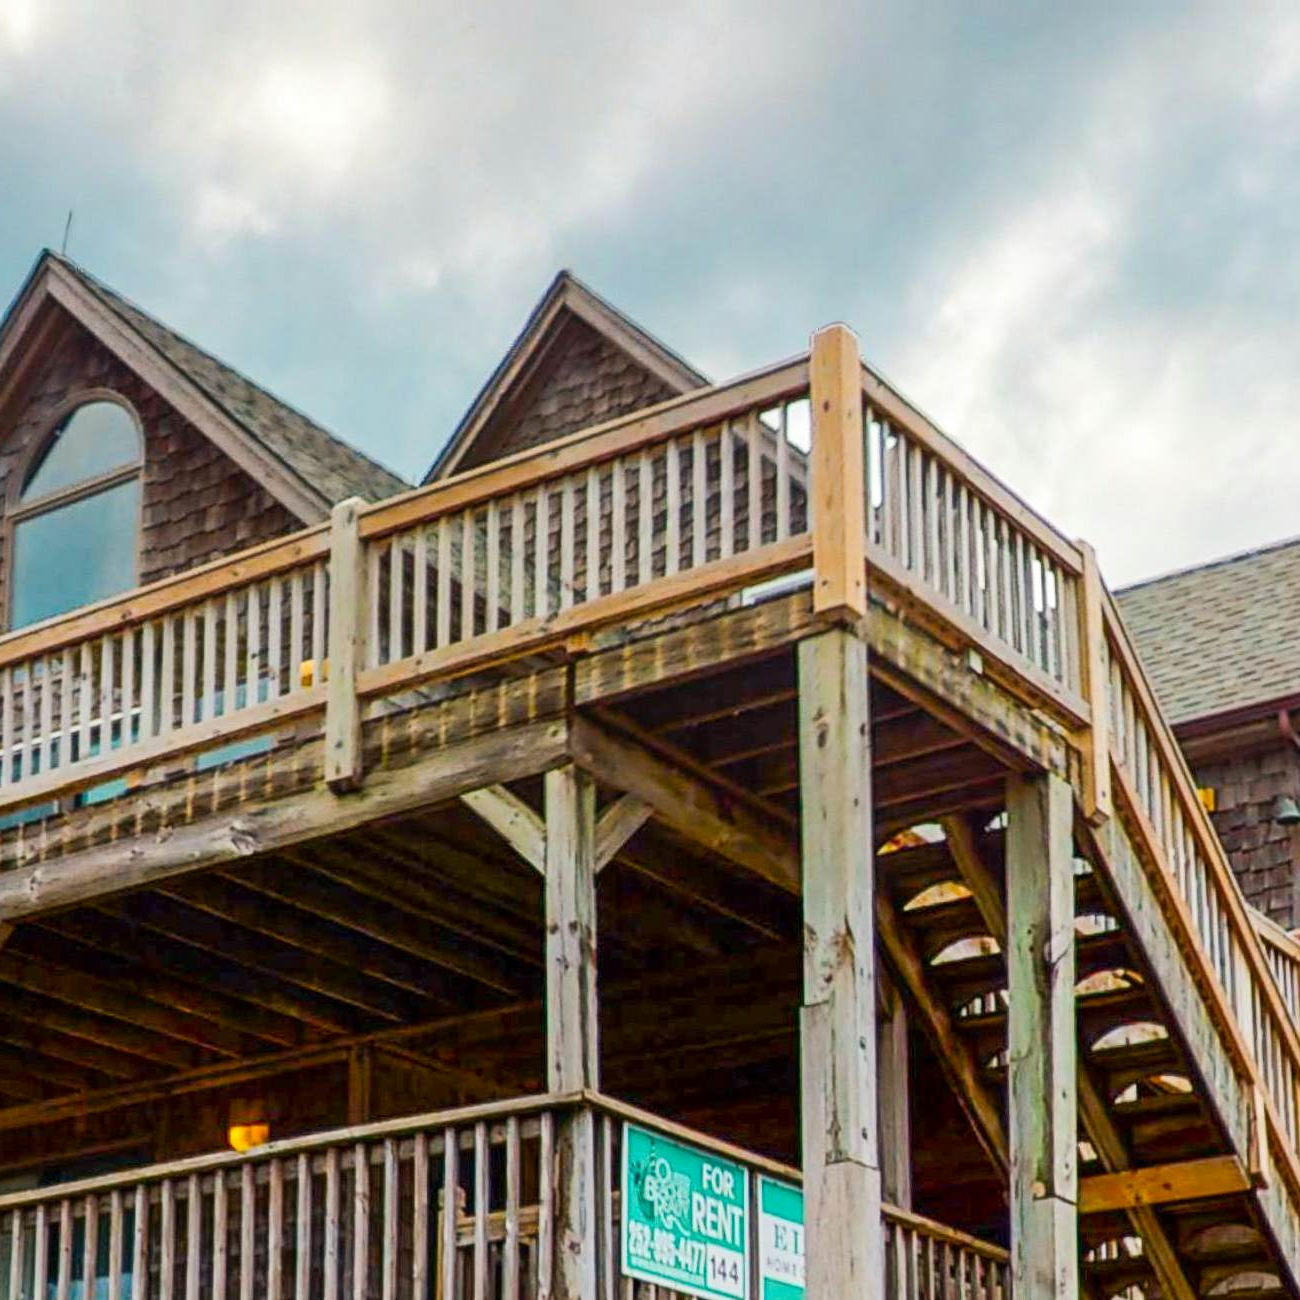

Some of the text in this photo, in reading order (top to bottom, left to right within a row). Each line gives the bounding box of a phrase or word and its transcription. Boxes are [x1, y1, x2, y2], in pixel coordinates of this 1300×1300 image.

[703, 1163, 735, 1200] FOR
[692, 1191, 744, 1248] RENT
[710, 1254, 739, 1285] 144
